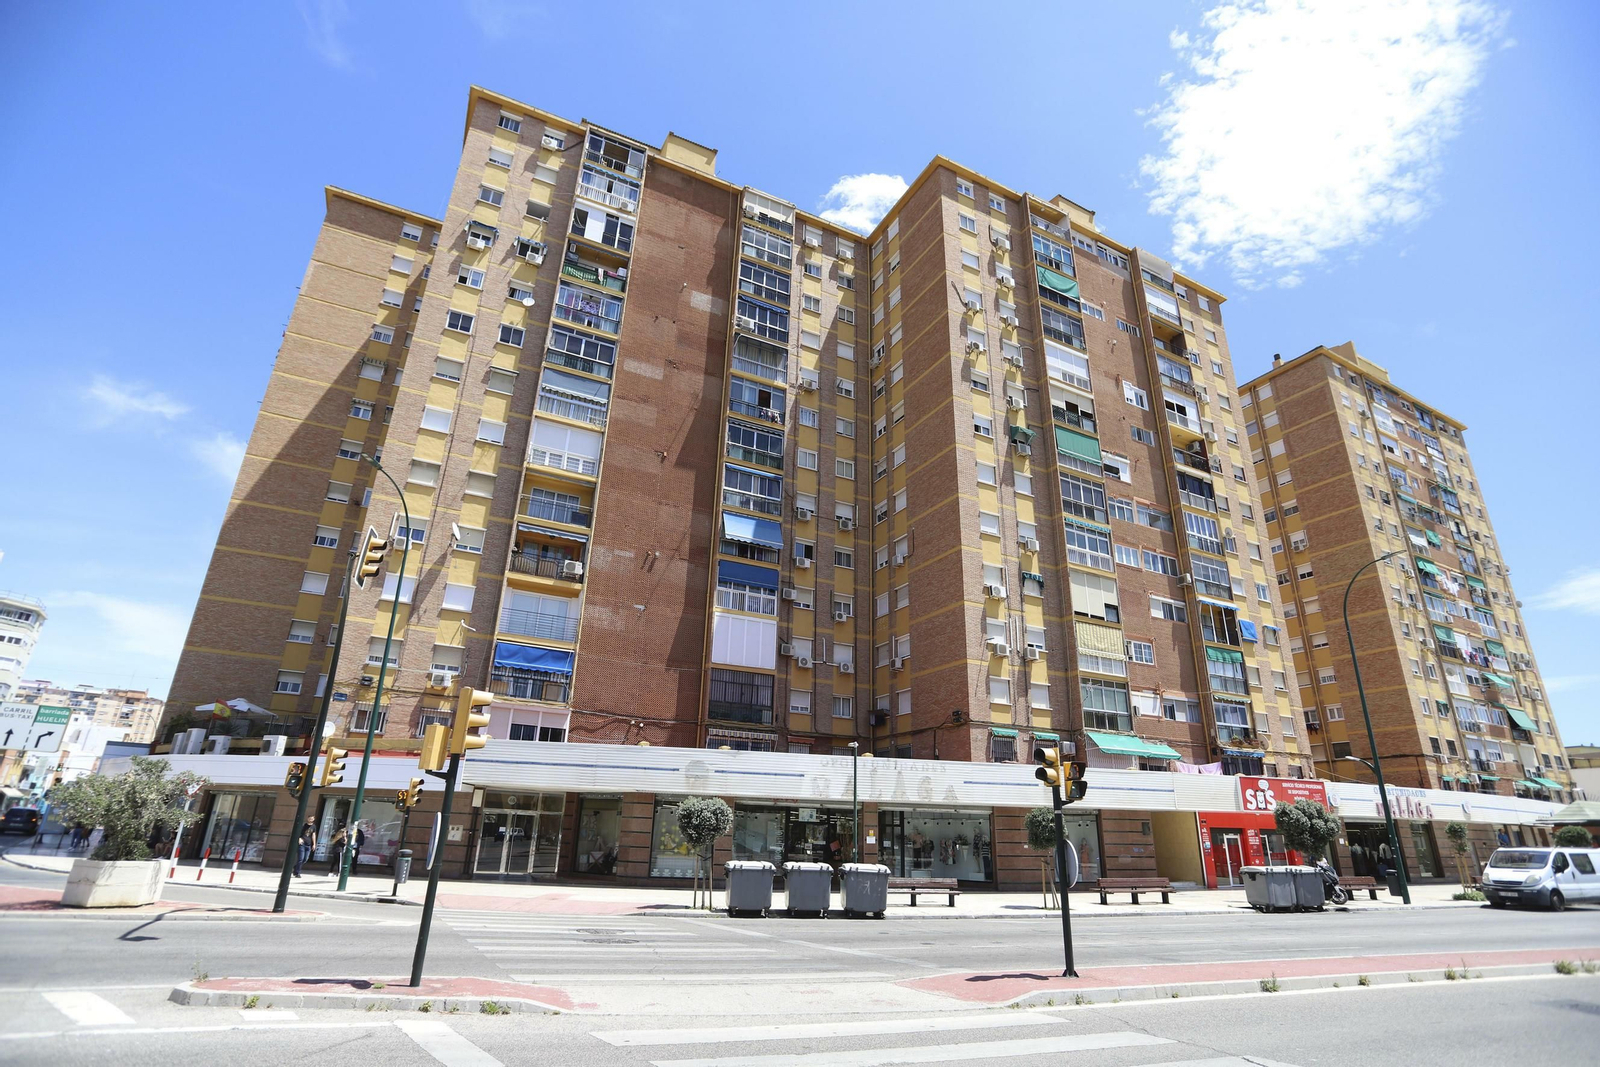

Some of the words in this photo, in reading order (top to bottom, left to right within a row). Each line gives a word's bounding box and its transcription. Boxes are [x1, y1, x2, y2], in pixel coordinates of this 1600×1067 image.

[3, 706, 33, 715] CARRIL
[40, 707, 69, 716] barriada
[36, 715, 68, 723] HUELIN
[398, 791, 407, 800] 57
